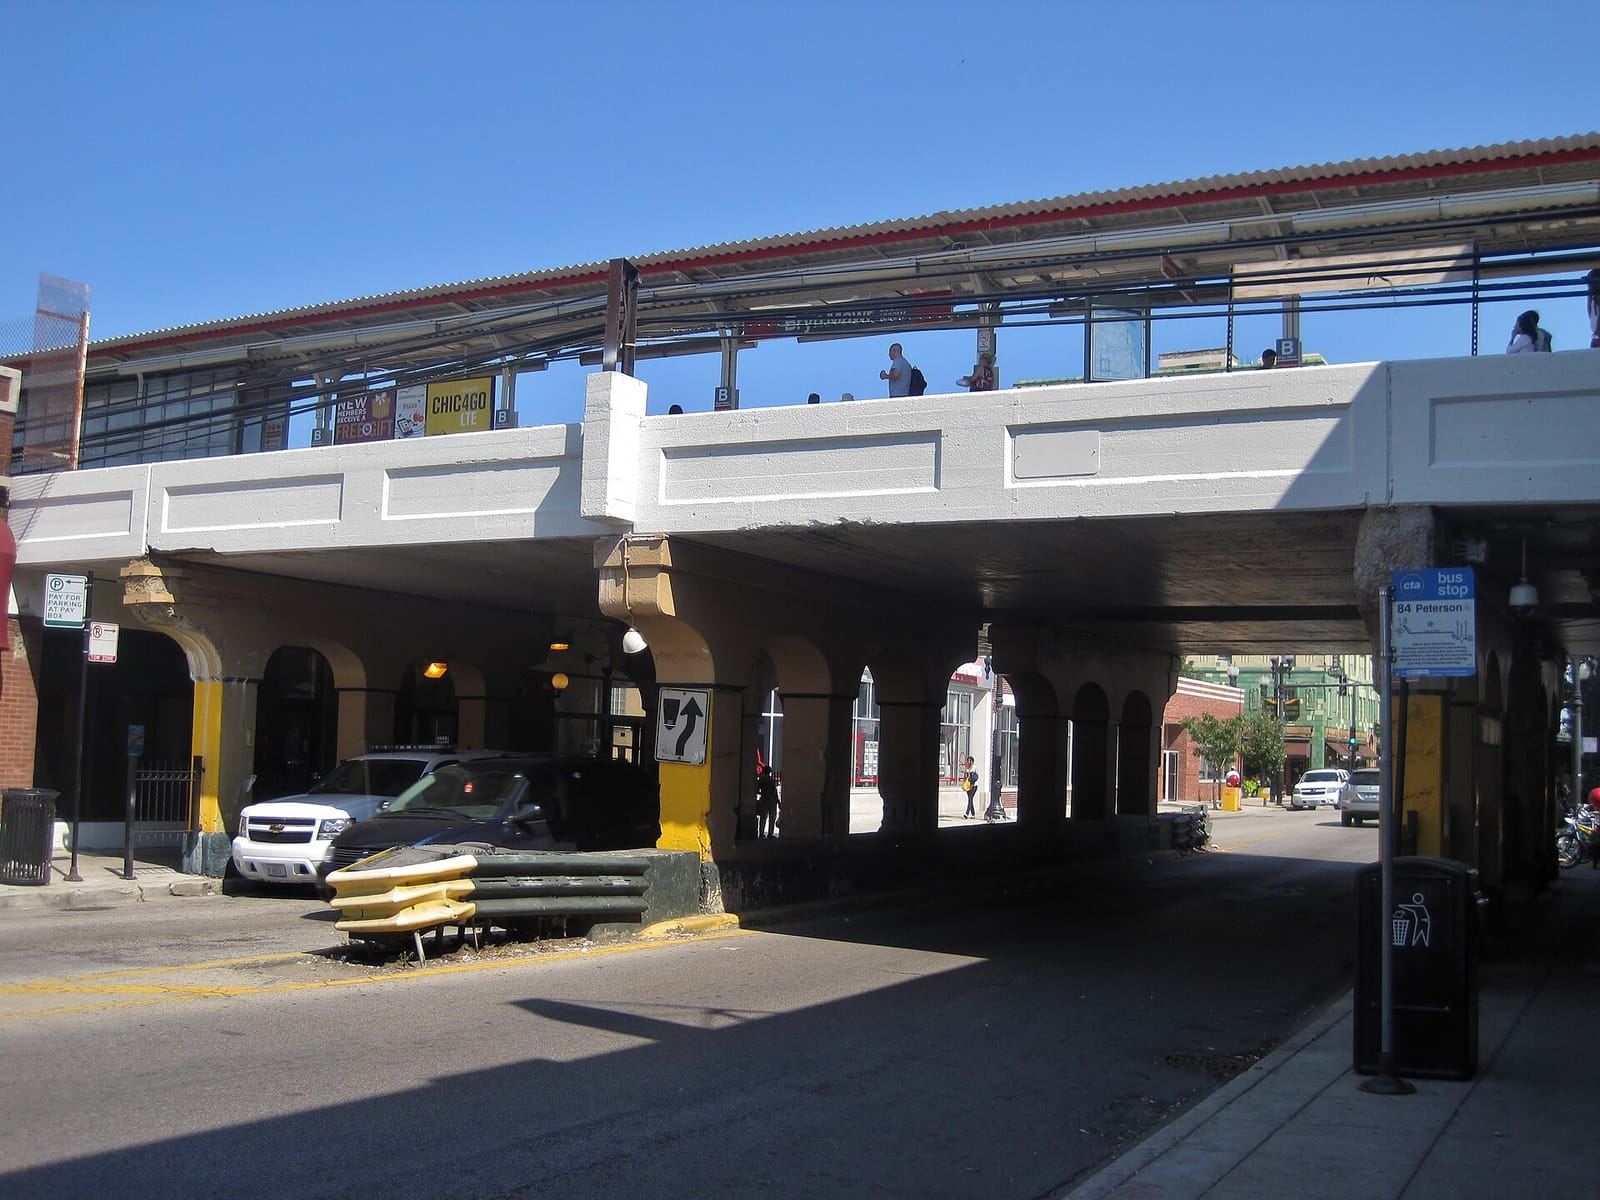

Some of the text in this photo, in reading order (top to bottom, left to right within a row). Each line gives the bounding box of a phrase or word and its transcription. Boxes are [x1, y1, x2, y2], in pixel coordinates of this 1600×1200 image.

[1281, 341, 1293, 355] B
[719, 389, 728, 401] B
[337, 397, 368, 411] NEW
[432, 391, 487, 414] CHIC4GO
[337, 408, 367, 418] MEMBERS
[460, 411, 477, 426] LTE
[499, 411, 507, 423] B
[314, 430, 322, 441] B
[335, 420, 393, 439] FREE GIFT
[1438, 572, 1464, 584] bus
[1438, 585, 1468, 598] stop
[48, 600, 82, 608] PARKING
[1397, 604, 1463, 613] 84 Peterson
